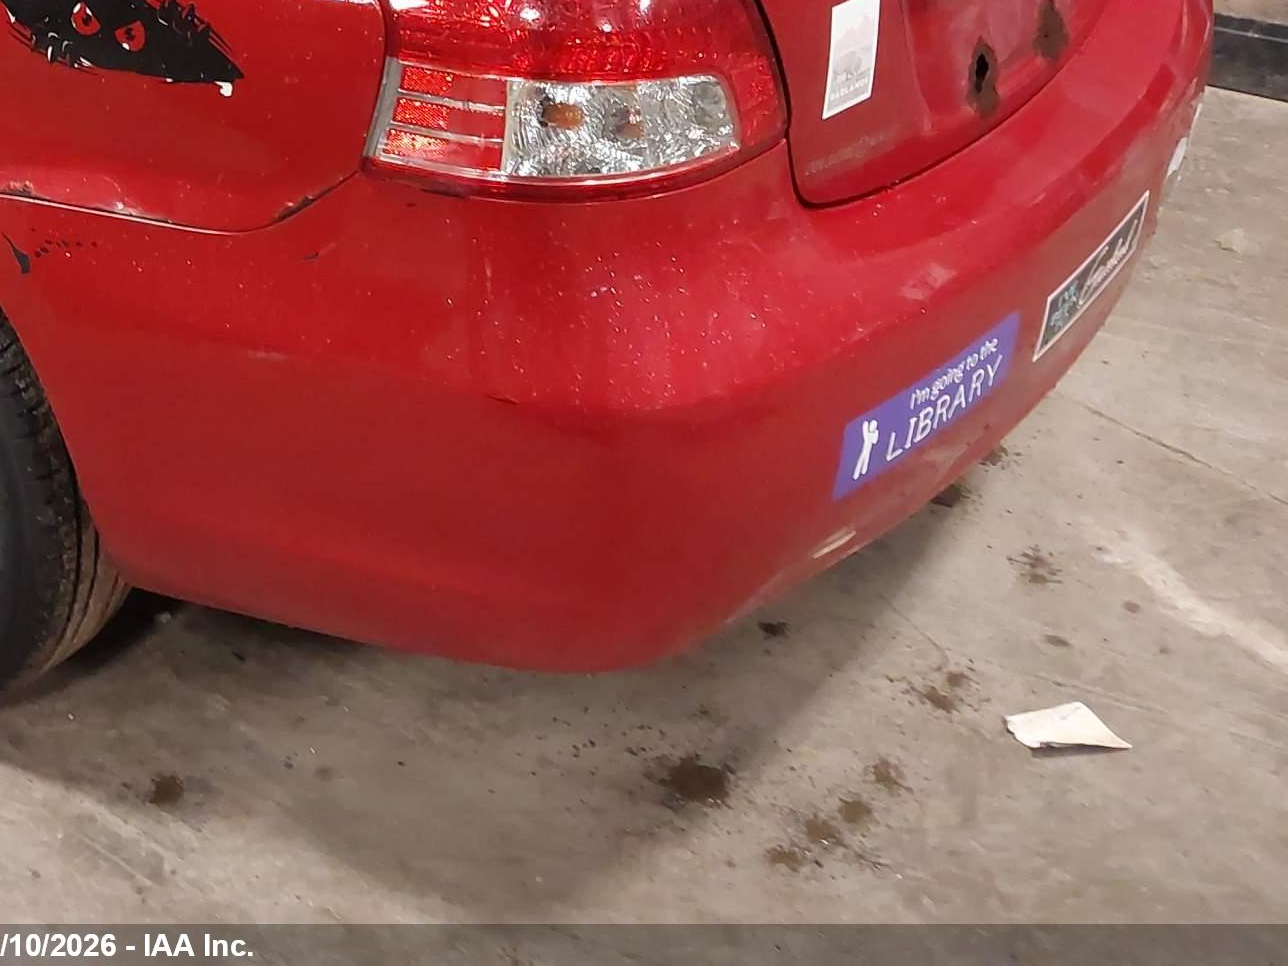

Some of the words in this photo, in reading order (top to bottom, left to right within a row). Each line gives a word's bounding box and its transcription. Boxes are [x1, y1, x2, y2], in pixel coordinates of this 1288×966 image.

[886, 354, 1004, 462] LIBRARY
[930, 361, 965, 401] going
[966, 353, 979, 371] to
[979, 338, 999, 360] the
